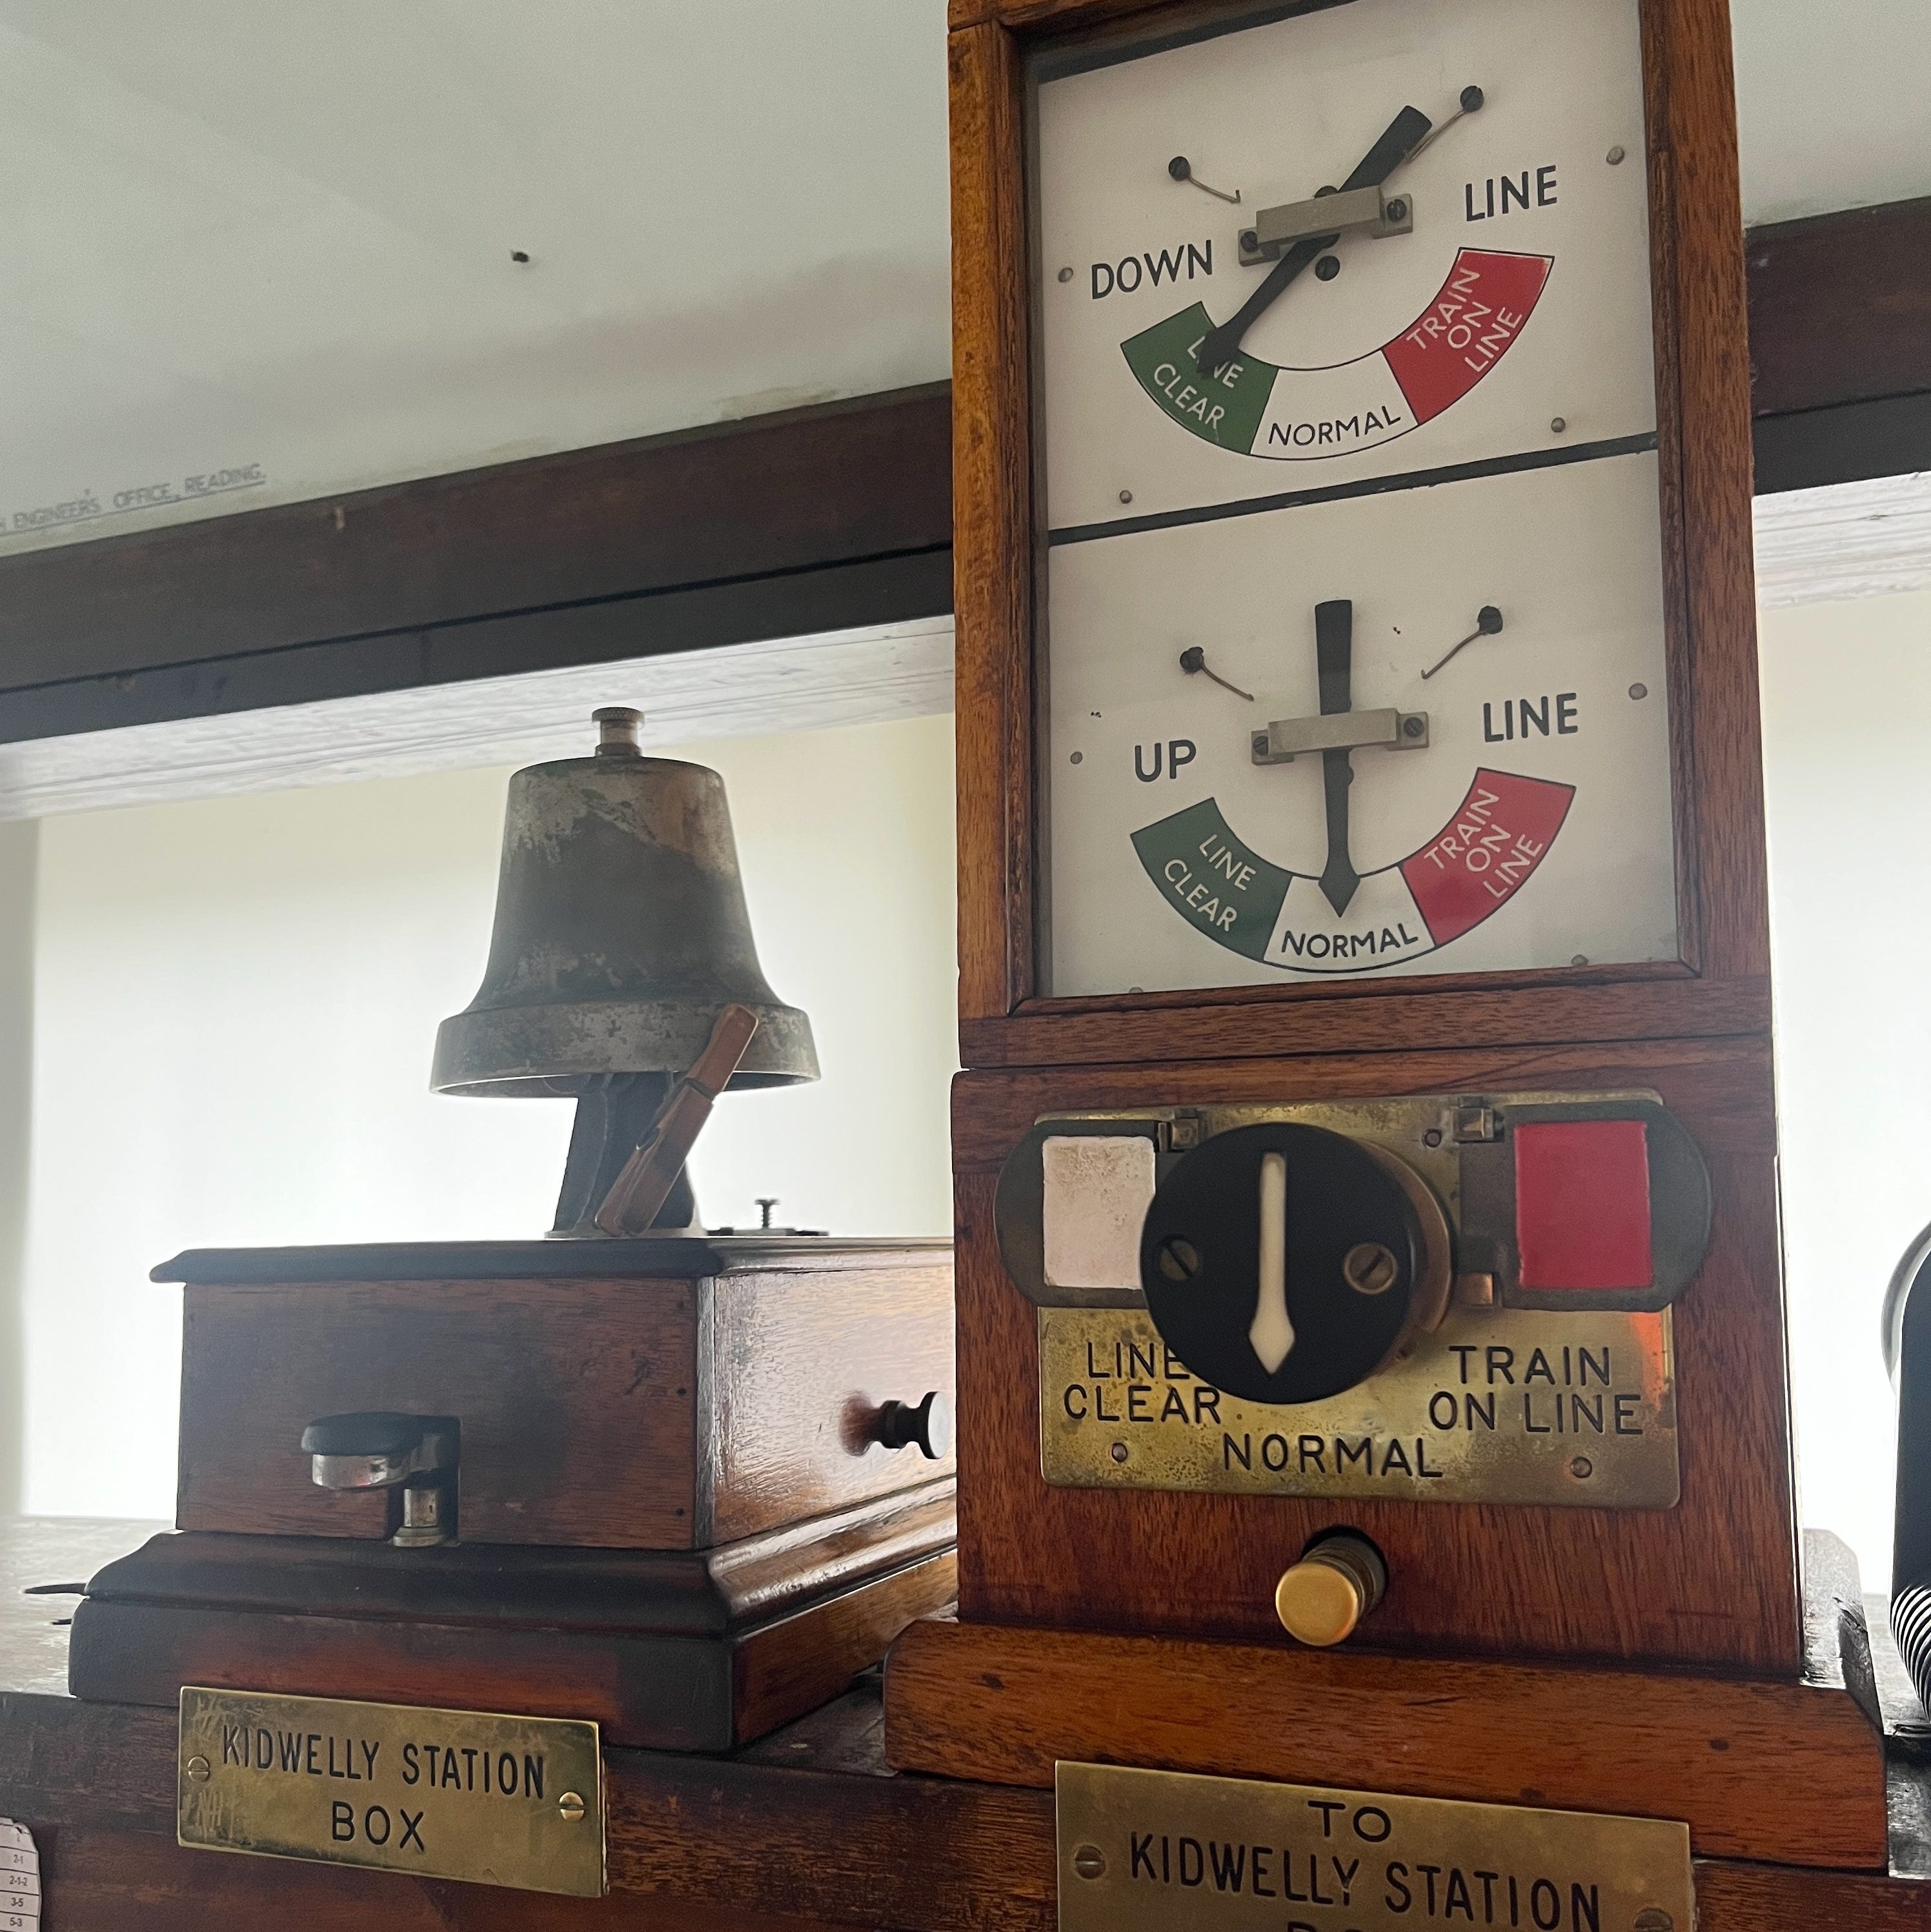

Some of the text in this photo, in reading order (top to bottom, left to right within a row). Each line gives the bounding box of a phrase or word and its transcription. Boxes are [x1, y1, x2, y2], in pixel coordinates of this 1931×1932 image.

[1465, 165, 1558, 221] LINE
[1091, 239, 1213, 299] DOWN
[1406, 267, 1481, 350] TRAIN
[1446, 301, 1492, 349] ON
[1464, 307, 1523, 373] LINE
[1153, 363, 1226, 430] CLEAR
[1267, 405, 1402, 447] NORMAL
[1483, 692, 1579, 743] LINE
[1134, 739, 1197, 782] UP
[1423, 788, 1501, 870] TRAIN
[1465, 823, 1512, 873] ON
[1198, 833, 1257, 892] LINE
[1482, 833, 1544, 900] LINE
[1164, 858, 1238, 932] CLEAR
[1280, 923, 1419, 958] NORMAL
[1087, 1342, 1191, 1380] LINE
[1449, 1344, 1612, 1387] TRAIN
[1064, 1384, 1221, 1424] CLEAR
[1428, 1391, 1644, 1435] ON LINE
[1222, 1433, 1443, 1479] NORMAL
[223, 1725, 544, 1799] KIDWELLY STATION
[332, 1801, 425, 1853] BOX
[1308, 1800, 1392, 1844] TO
[9, 1875, 28, 1887] 2-1-2
[10, 1897, 24, 1907] 3-5
[1130, 1831, 1601, 1932] KIDWELLY STATION
[9, 1917, 23, 1927] 5-3
